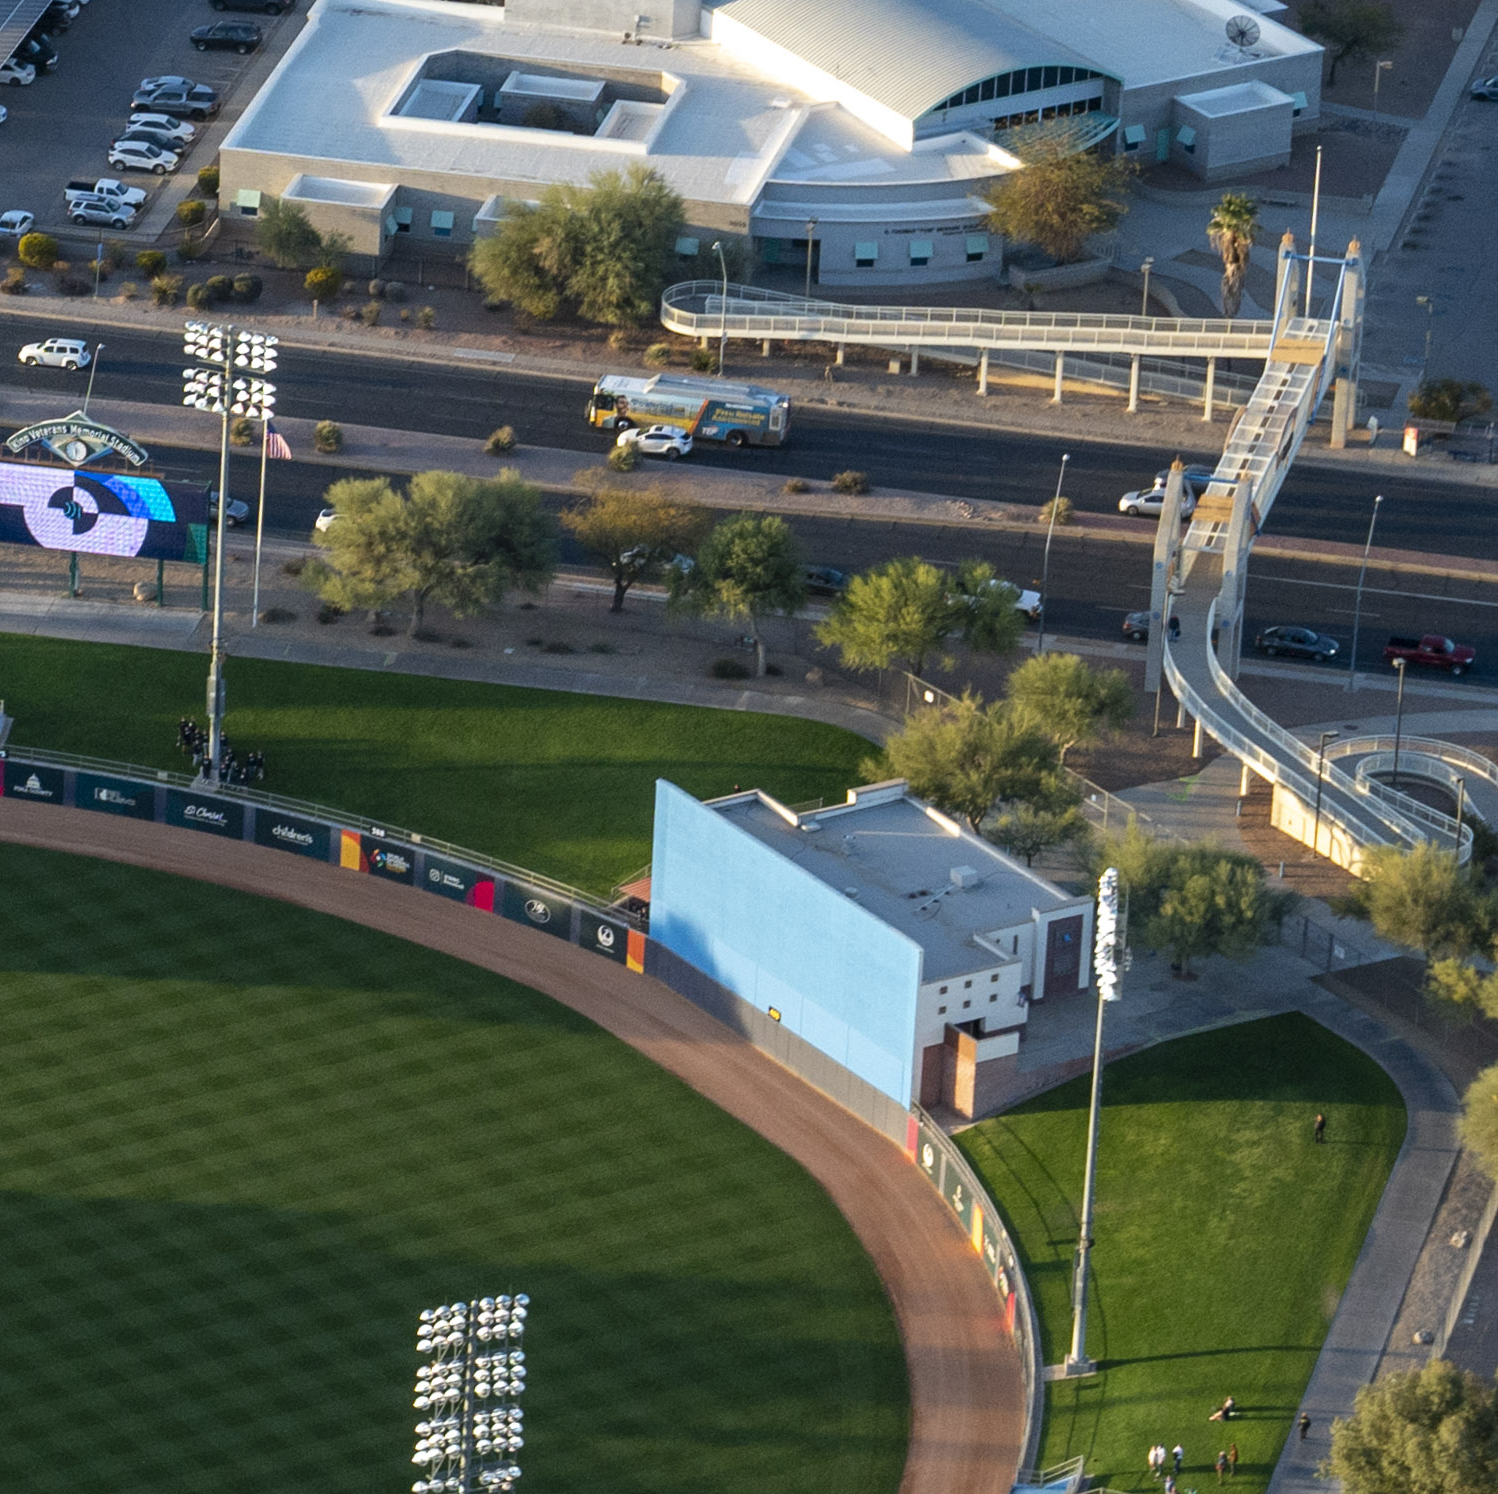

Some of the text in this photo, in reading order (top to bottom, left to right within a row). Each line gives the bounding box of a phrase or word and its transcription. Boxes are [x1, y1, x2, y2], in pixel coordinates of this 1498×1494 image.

[11, 424, 140, 463] Kino Veterans Memorial Stadium
